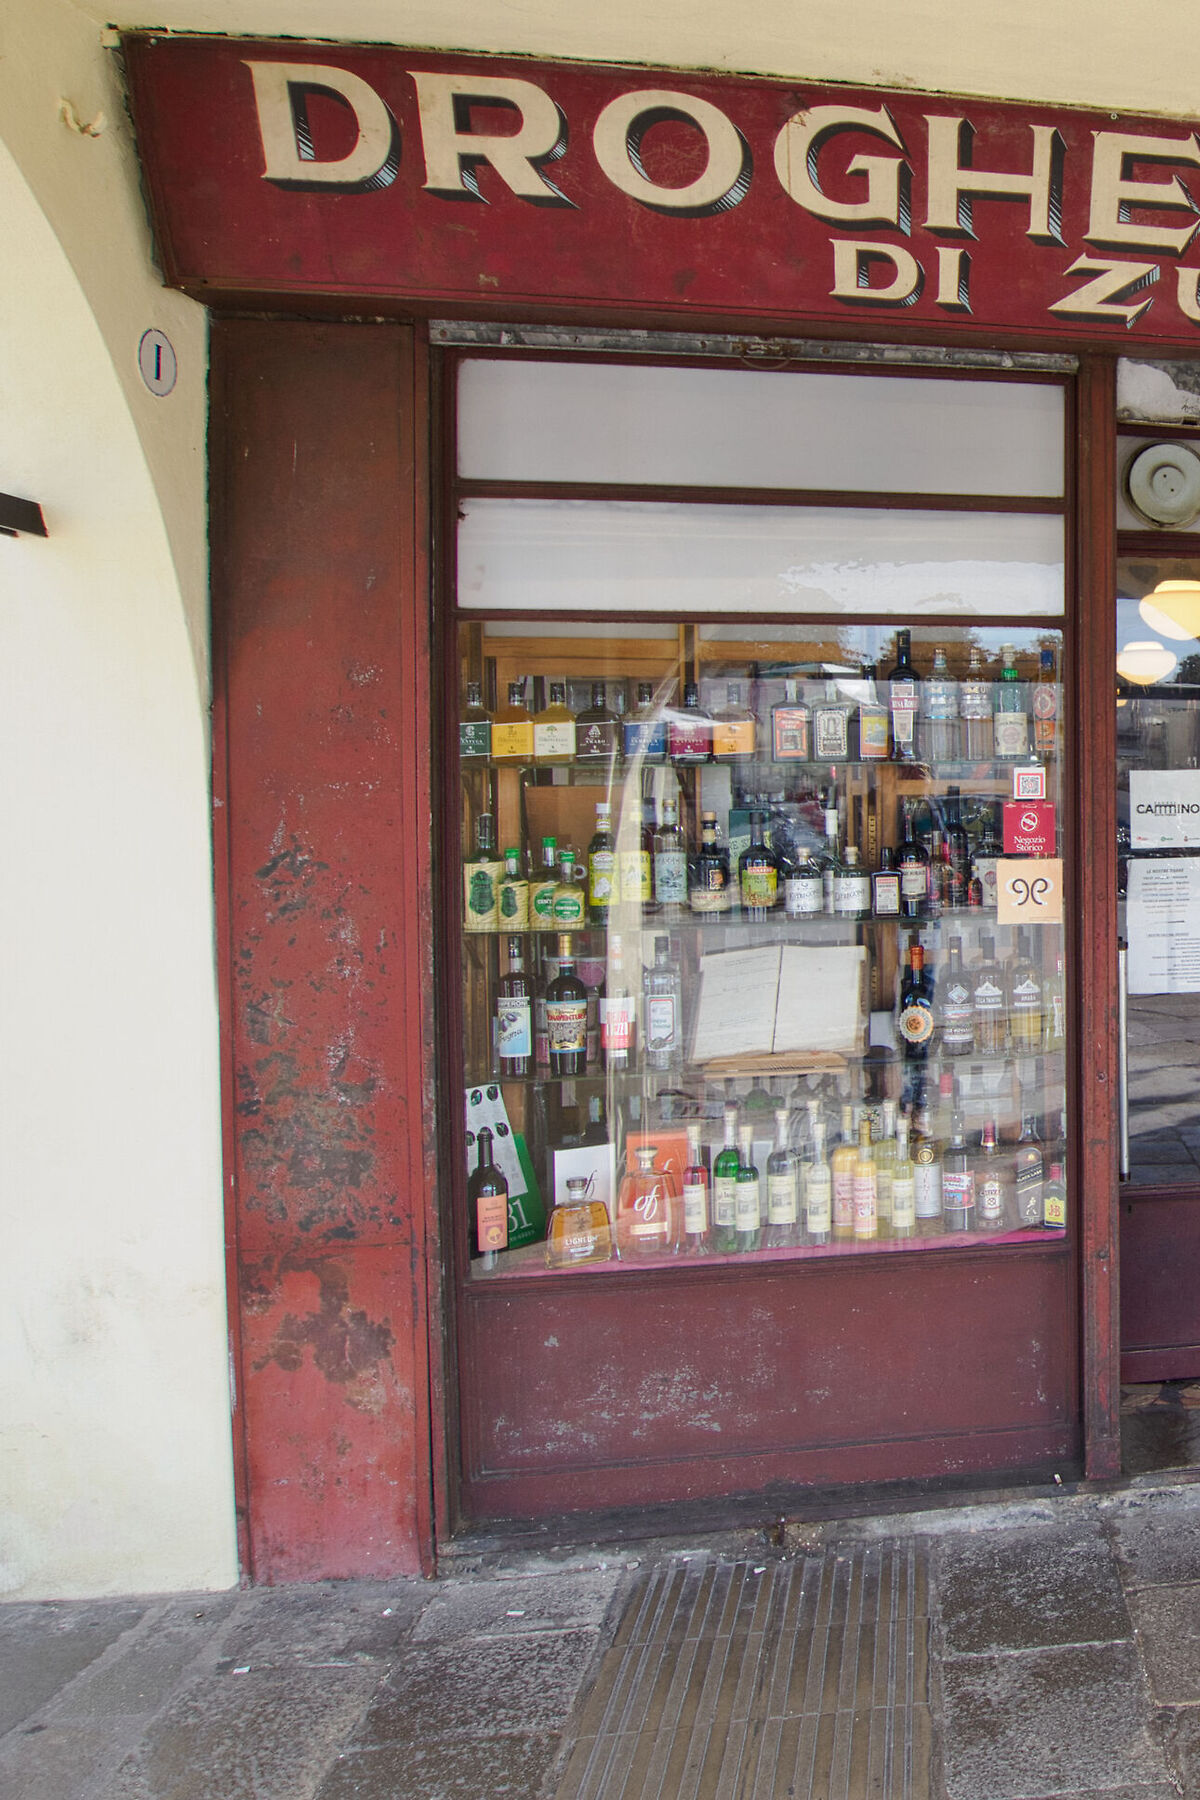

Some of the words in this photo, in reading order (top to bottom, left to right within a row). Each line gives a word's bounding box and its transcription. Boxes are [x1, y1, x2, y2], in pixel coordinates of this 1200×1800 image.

[828, 238, 973, 313] DI
[1014, 836, 1046, 845] Negozio
[1016, 843, 1043, 852] Storico
